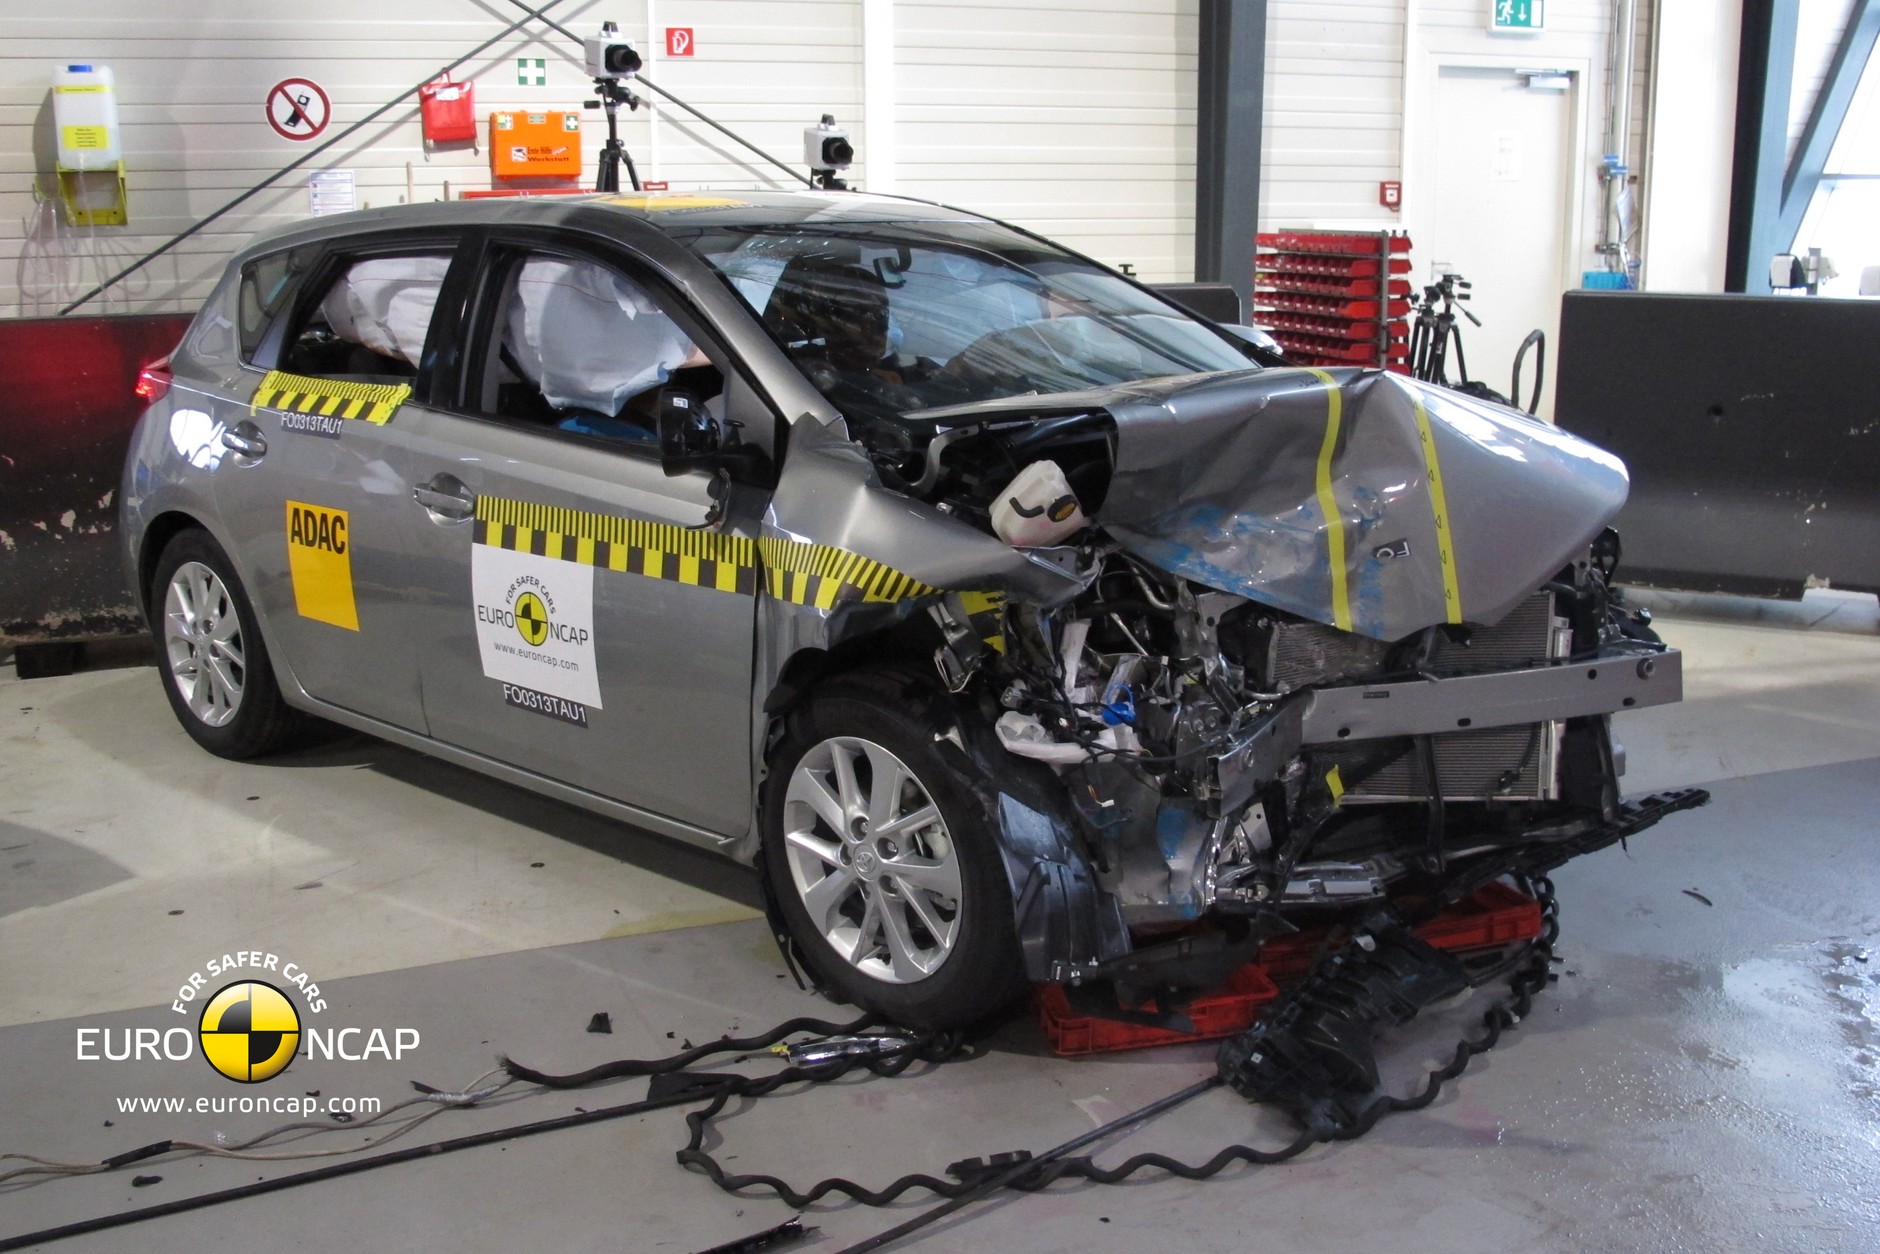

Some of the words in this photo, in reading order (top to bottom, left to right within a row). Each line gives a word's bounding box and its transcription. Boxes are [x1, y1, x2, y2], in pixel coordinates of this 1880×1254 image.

[281, 411, 342, 434] FO0313TAU1
[291, 507, 346, 555] ADAC
[506, 583, 517, 605] FOR
[515, 576, 540, 588] SAFER
[540, 585, 556, 614] CARS
[477, 604, 515, 629] EURO
[549, 621, 589, 646] NCAP
[493, 642, 579, 672] www.euroncap.com
[502, 683, 586, 723] FO0313TAU1
